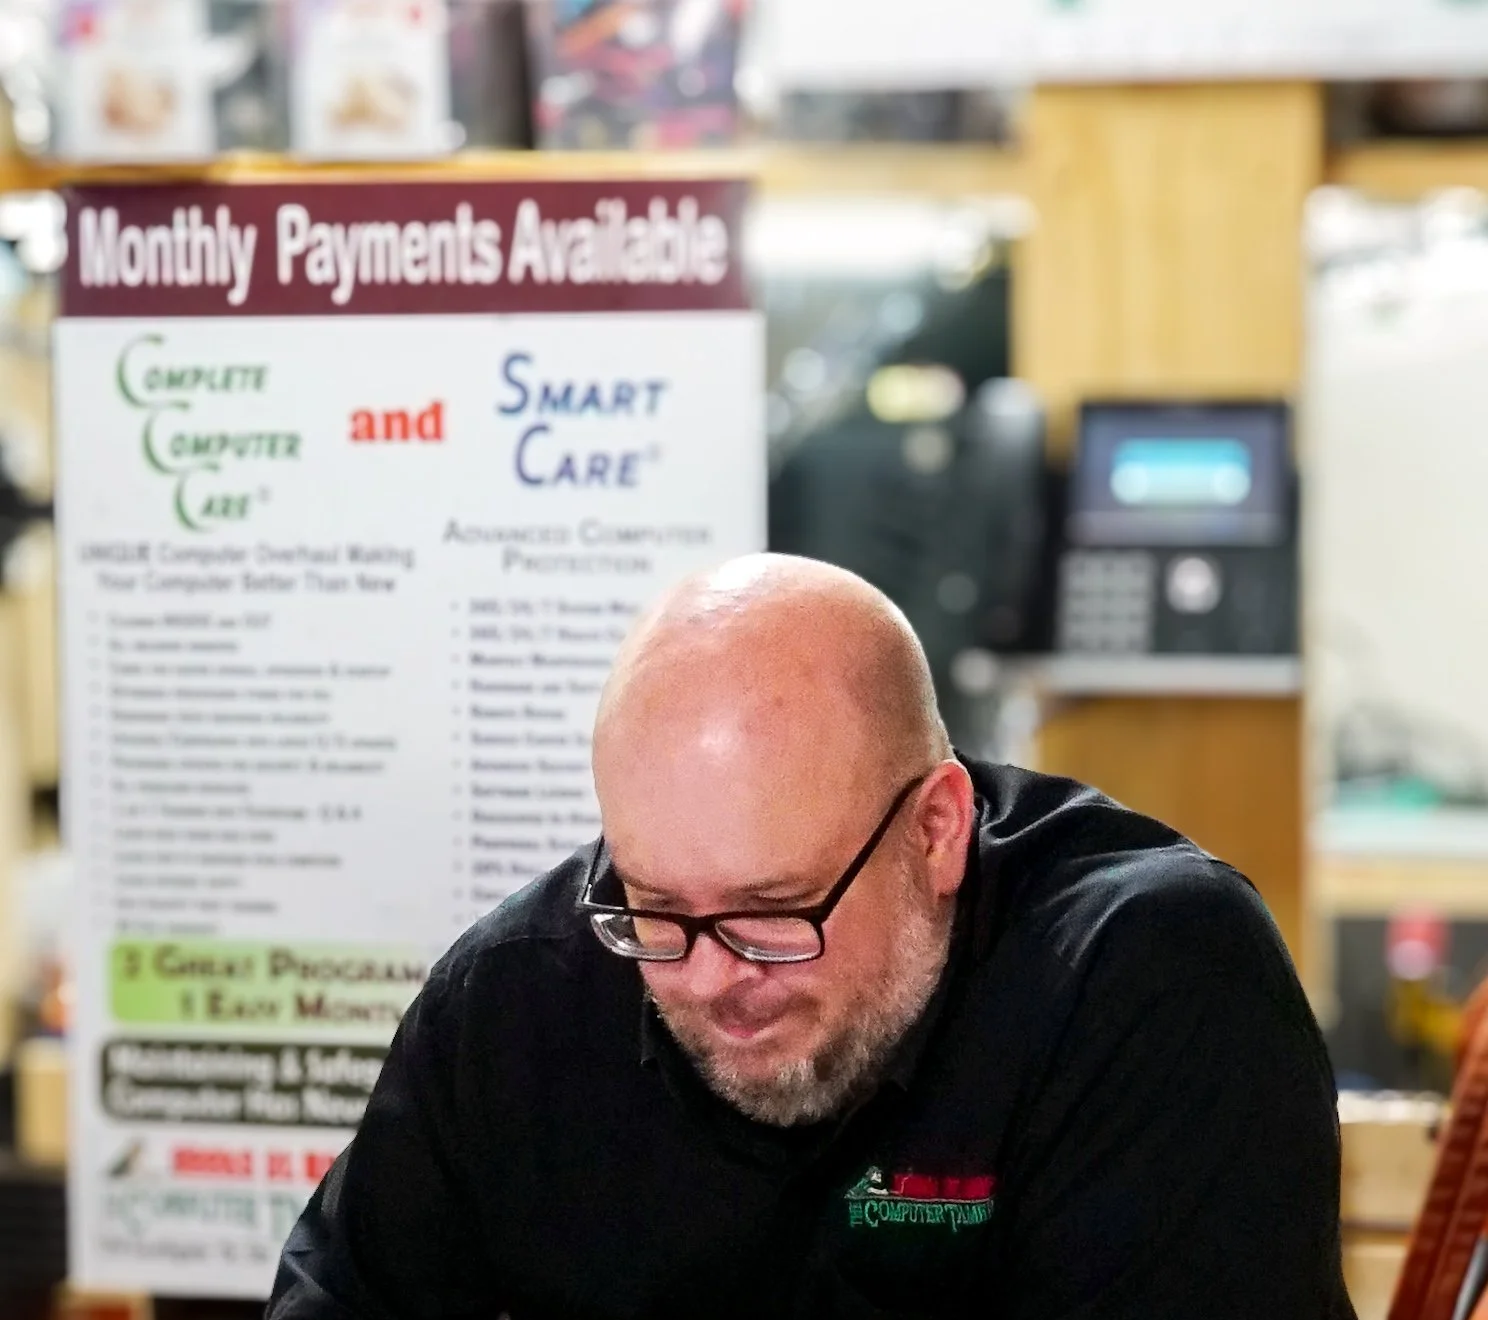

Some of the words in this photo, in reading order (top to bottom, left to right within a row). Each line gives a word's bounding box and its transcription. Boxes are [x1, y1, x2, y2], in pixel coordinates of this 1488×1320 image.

[79, 204, 257, 305] Monthly
[277, 201, 503, 306] Payments
[507, 196, 728, 286] Available
[349, 402, 444, 442] and
[160, 542, 247, 568] Computer
[865, 1200, 946, 1228] COMPUTER
